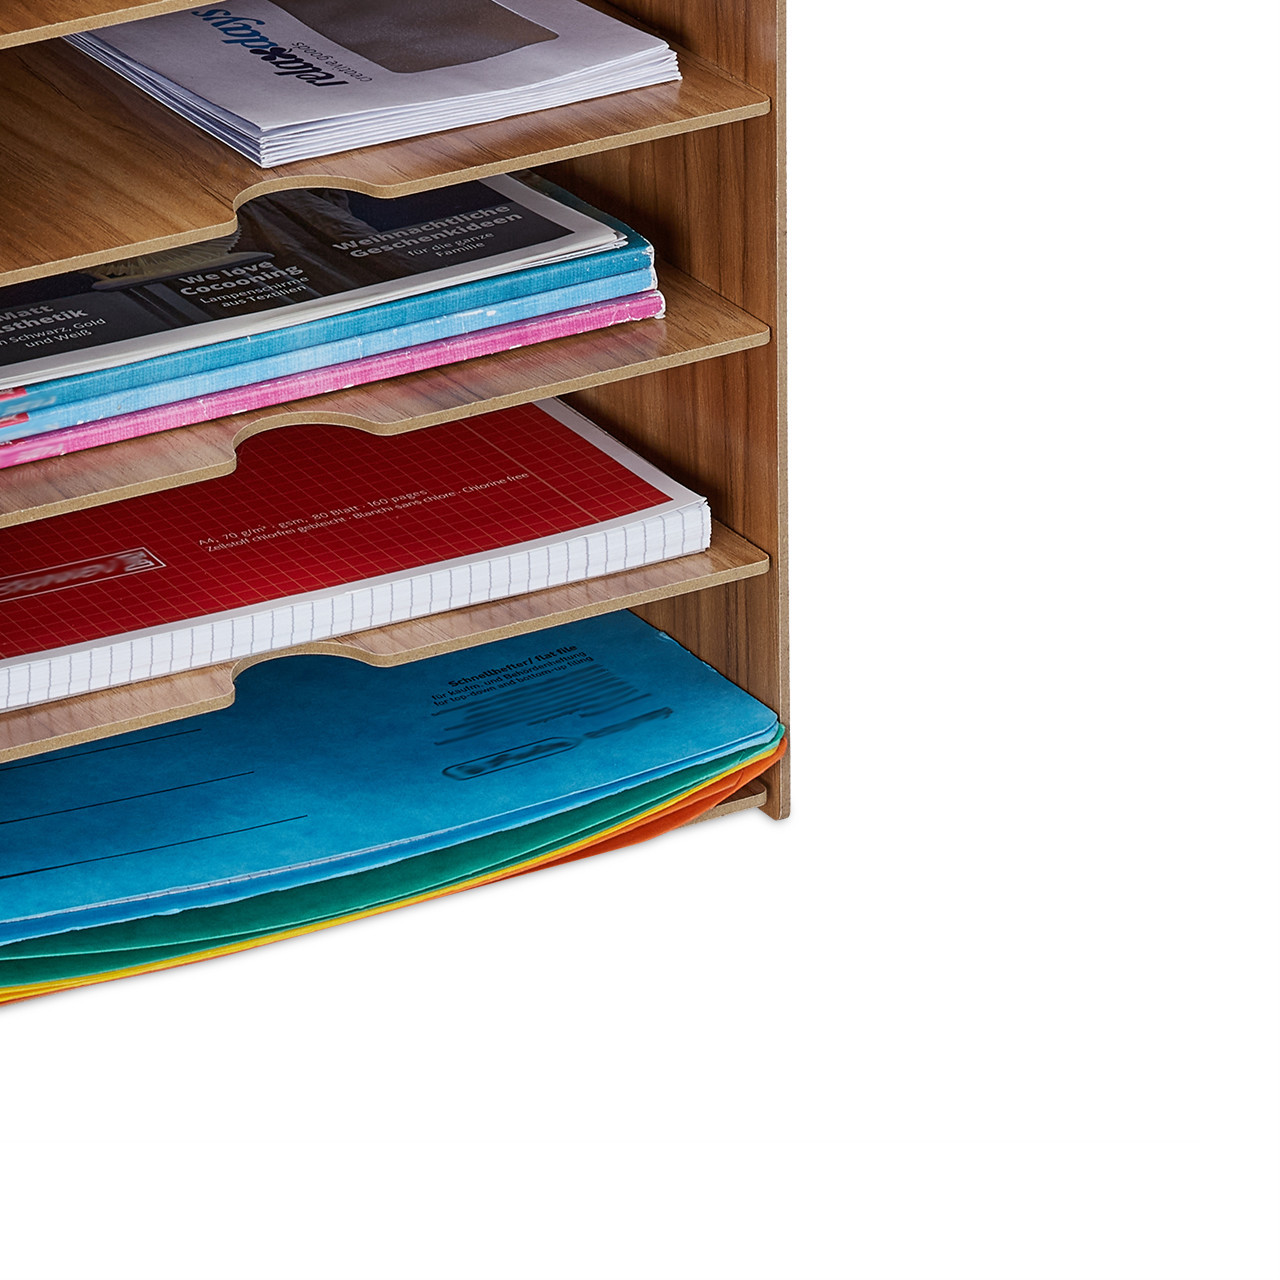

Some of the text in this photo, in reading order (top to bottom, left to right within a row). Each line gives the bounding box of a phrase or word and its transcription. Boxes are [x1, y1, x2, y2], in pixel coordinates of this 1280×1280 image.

[191, 8, 349, 87] relaxdays
[290, 41, 373, 83] creative goods
[332, 204, 511, 252] Weihnachtliche
[349, 213, 523, 259] Geschenkideen
[407, 232, 495, 257] für die ganze
[435, 242, 486, 258] Familie
[179, 261, 274, 285] We love
[180, 265, 304, 296] Cocooning
[199, 276, 310, 304] Lampenschirme
[221, 285, 307, 308] aus Textilien
[8, 326, 72, 343] Schwarz,
[73, 318, 107, 330] Gold
[25, 329, 92, 348] und Weiß
[205, 537, 251, 553] Zellstoff
[251, 528, 297, 543] chlorfrei
[297, 516, 347, 533] gebleicht
[394, 499, 422, 510] sans
[422, 490, 457, 504] chlore
[461, 478, 507, 494] Chlorine
[506, 472, 530, 482] free
[222, 532, 239, 540] 70
[277, 518, 309, 529] gsm,
[311, 512, 329, 521] 80
[330, 504, 360, 517] Blatt
[391, 489, 428, 504] pages
[534, 650, 559, 662] flat
[556, 644, 578, 655] file
[483, 676, 504, 687] und
[497, 679, 517, 689] and
